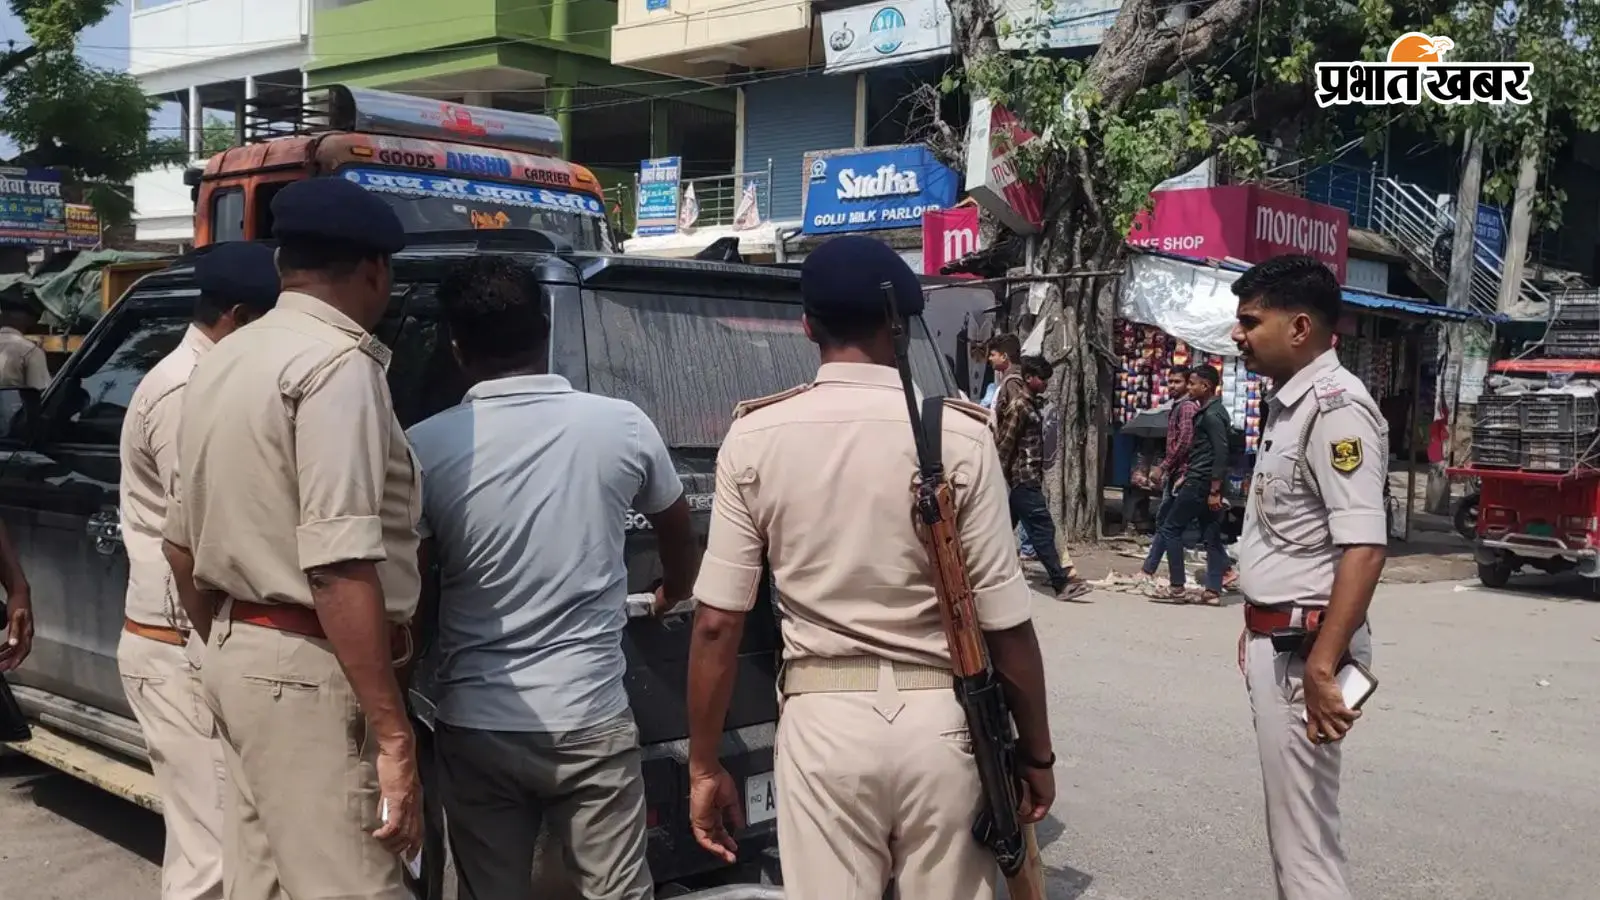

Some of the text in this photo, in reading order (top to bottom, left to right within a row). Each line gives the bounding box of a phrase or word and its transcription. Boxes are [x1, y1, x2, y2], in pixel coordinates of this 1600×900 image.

[379, 149, 571, 185] GOODS ANSHU CARRIER
[837, 163, 921, 200] Sudha
[814, 213, 846, 227] GOLU
[848, 210, 877, 224] MILK
[1163, 236, 1204, 251] SHOP
